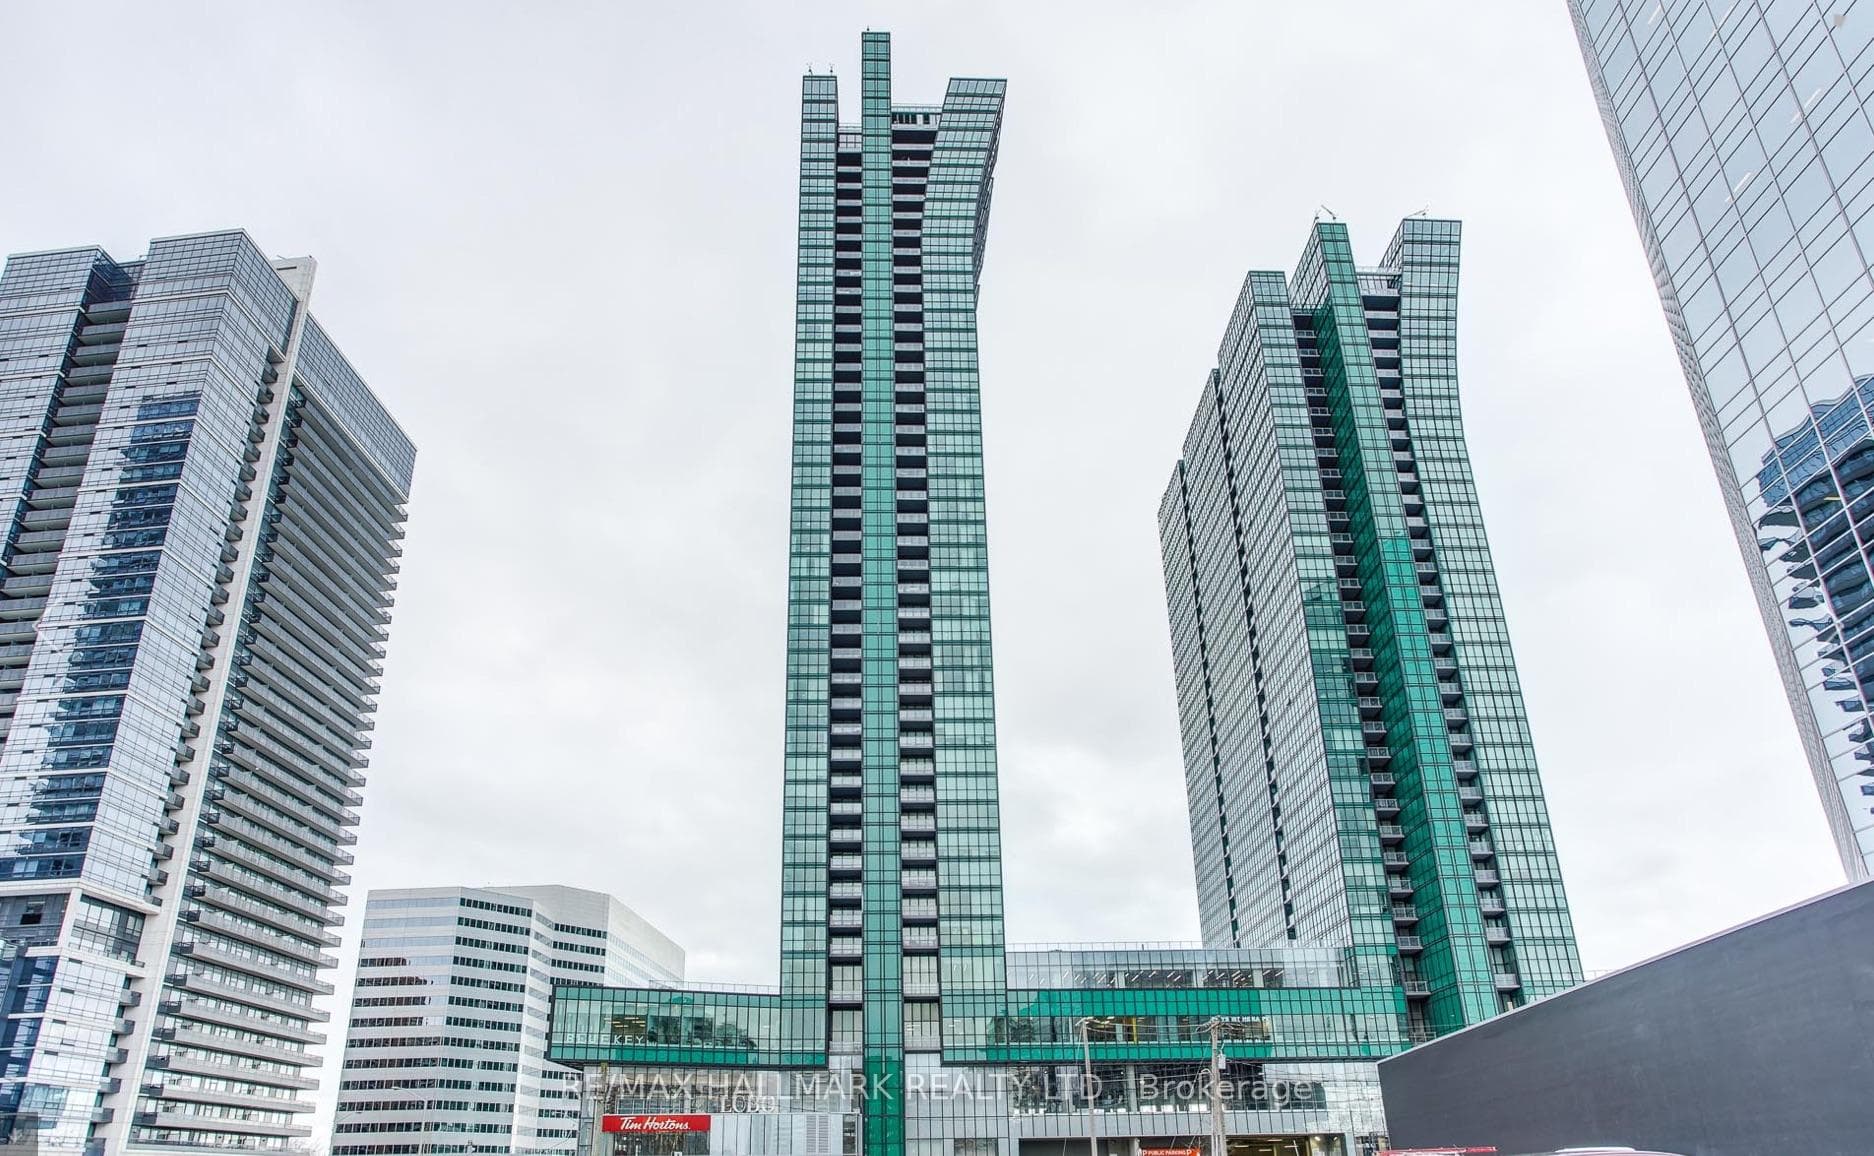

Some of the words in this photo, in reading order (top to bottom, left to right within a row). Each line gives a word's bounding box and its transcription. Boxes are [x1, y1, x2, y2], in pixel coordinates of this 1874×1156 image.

[613, 1034, 644, 1045] KEY
[620, 1116, 642, 1130] Tim
[642, 1116, 689, 1130] Hortons
